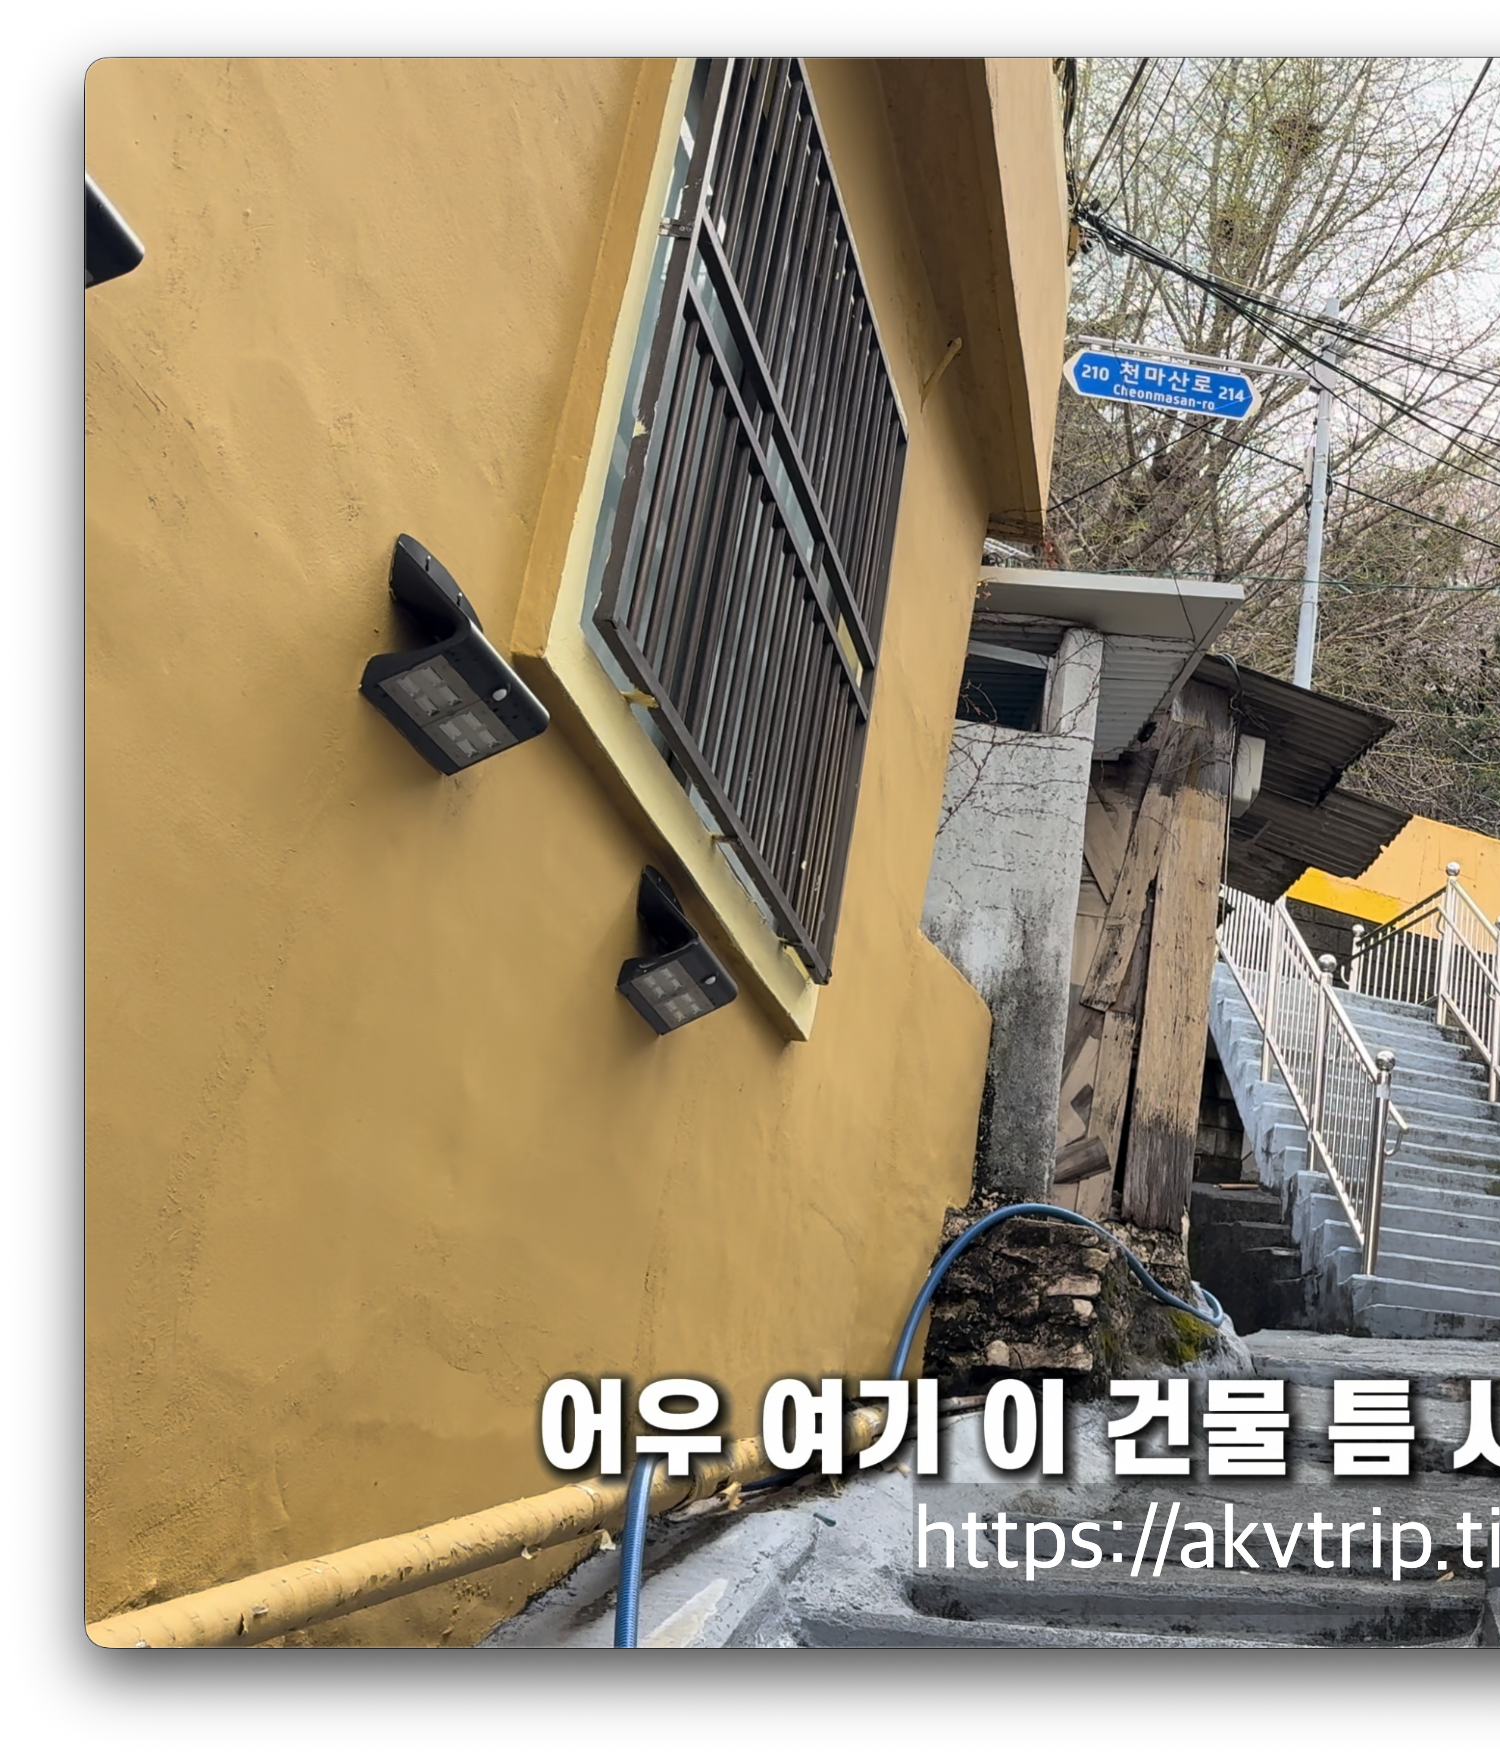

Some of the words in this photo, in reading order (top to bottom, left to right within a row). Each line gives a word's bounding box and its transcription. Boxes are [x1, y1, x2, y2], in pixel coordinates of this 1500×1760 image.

[1081, 363, 1110, 382] 210
[1119, 361, 1213, 394] 천마산로
[1217, 386, 1245, 403] 214
[1112, 383, 1216, 411] Cheonmasan-ro
